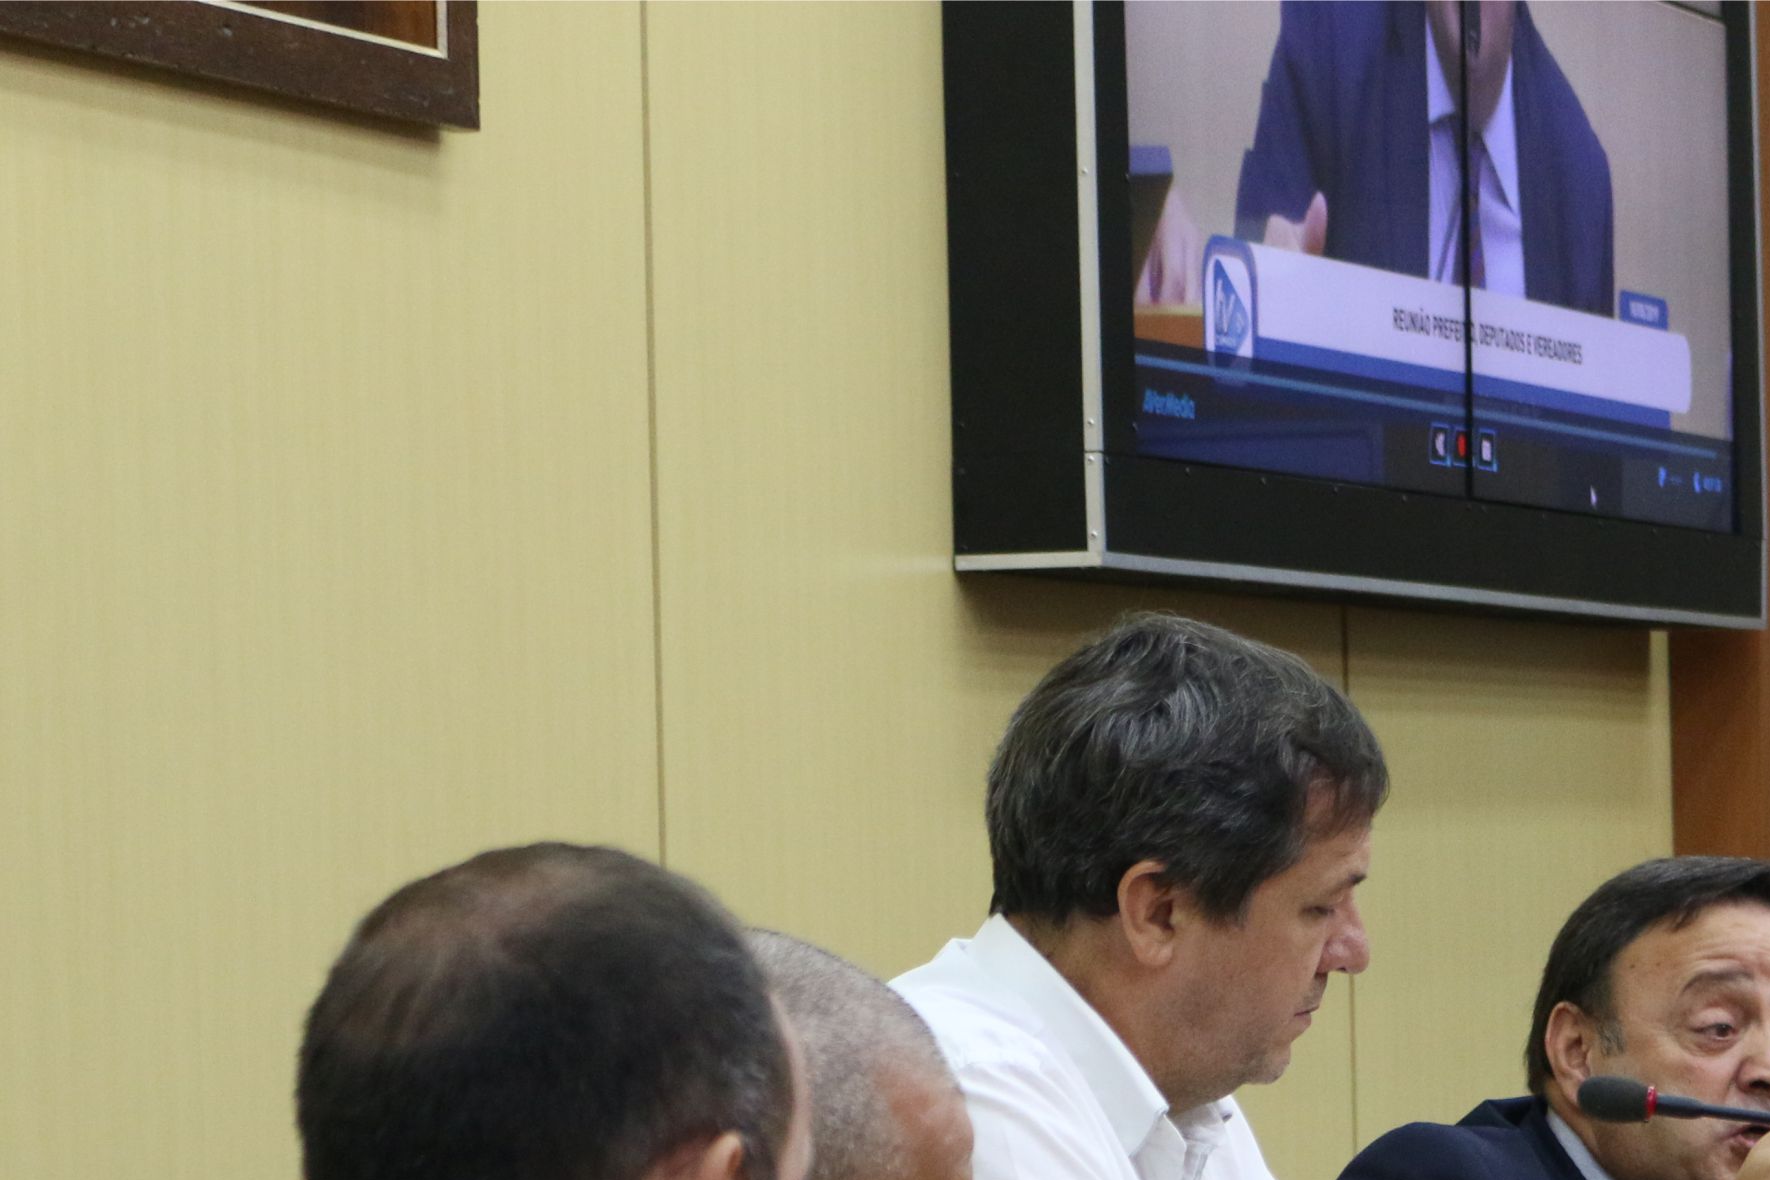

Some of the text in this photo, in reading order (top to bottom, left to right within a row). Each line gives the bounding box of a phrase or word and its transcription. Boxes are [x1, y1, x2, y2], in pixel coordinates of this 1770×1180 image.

[1392, 306, 1431, 336] REUNIÃO
[1479, 323, 1526, 354] DEPUTADOS
[1533, 334, 1584, 366] VEREADORES
